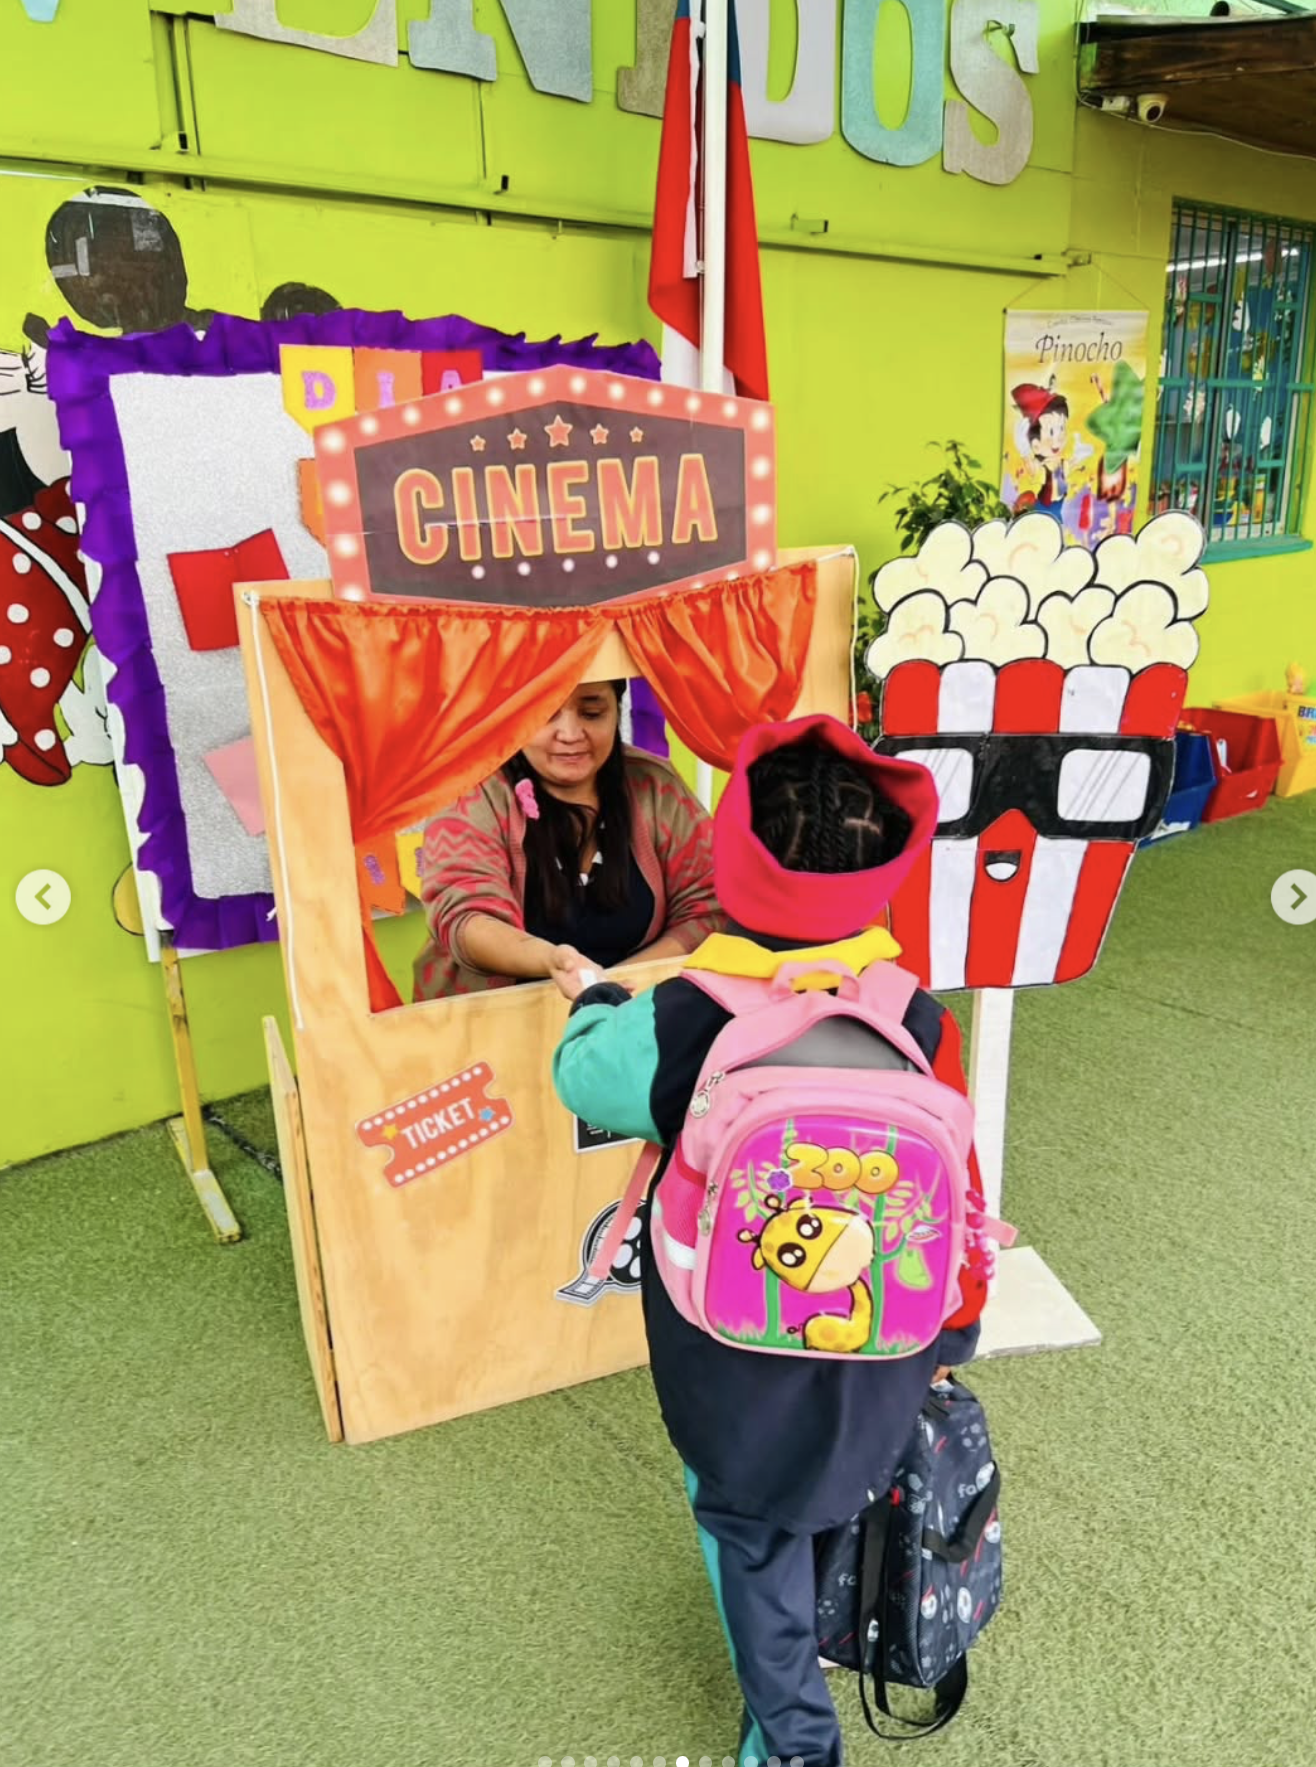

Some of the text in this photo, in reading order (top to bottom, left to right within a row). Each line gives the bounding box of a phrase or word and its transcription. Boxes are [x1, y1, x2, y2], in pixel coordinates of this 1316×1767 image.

[1035, 331, 1123, 363] Pinocho
[394, 453, 718, 564] CINEMA
[401, 1097, 475, 1149] TICKET
[784, 1141, 899, 1194] ZOO
